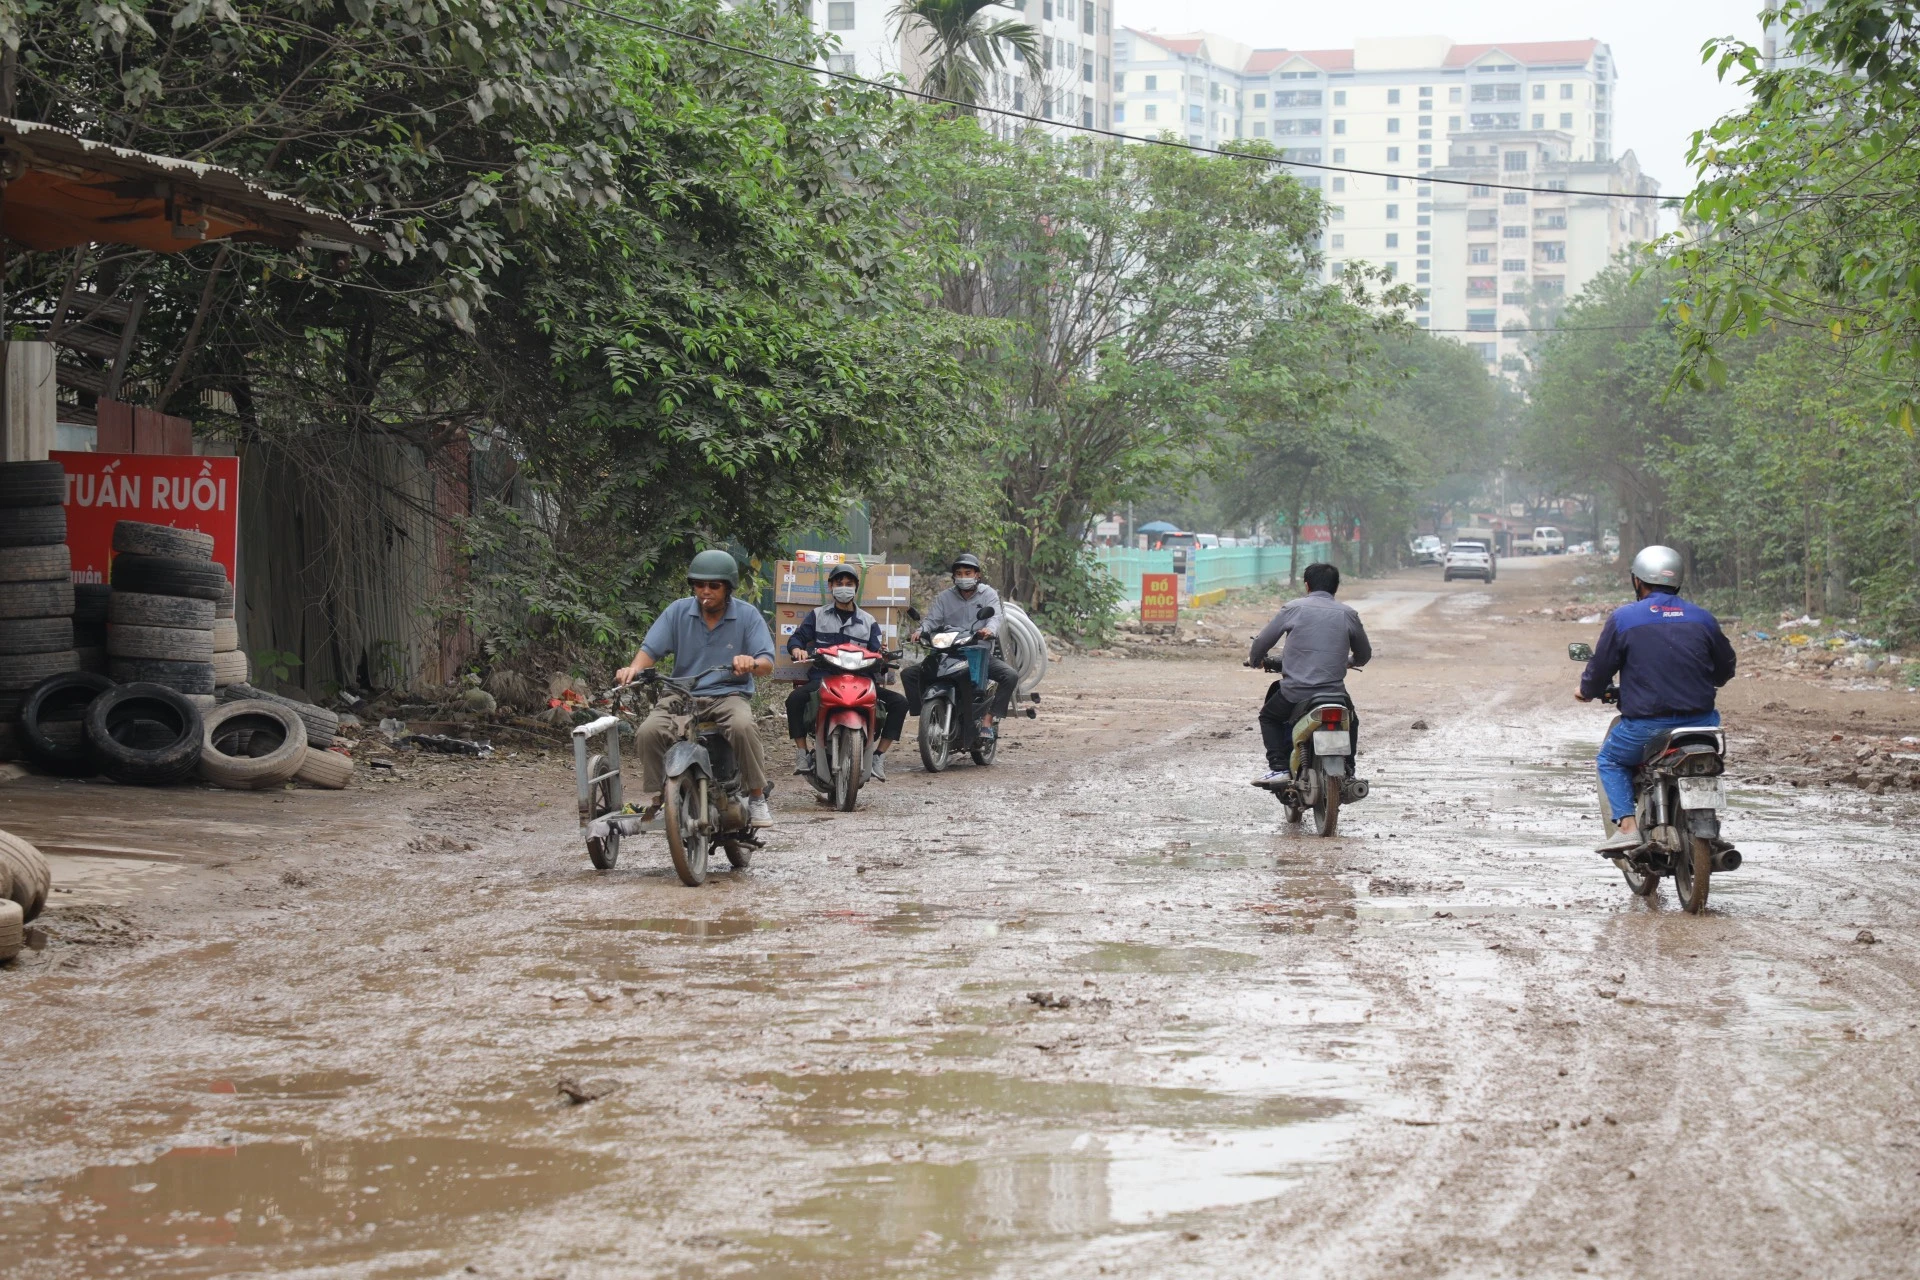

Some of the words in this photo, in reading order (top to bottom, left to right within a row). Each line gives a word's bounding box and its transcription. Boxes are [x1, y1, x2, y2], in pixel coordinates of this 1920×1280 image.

[63, 459, 141, 508] TUẤN
[152, 459, 226, 511] RUỒI
[1144, 593, 1174, 608] MỘC
